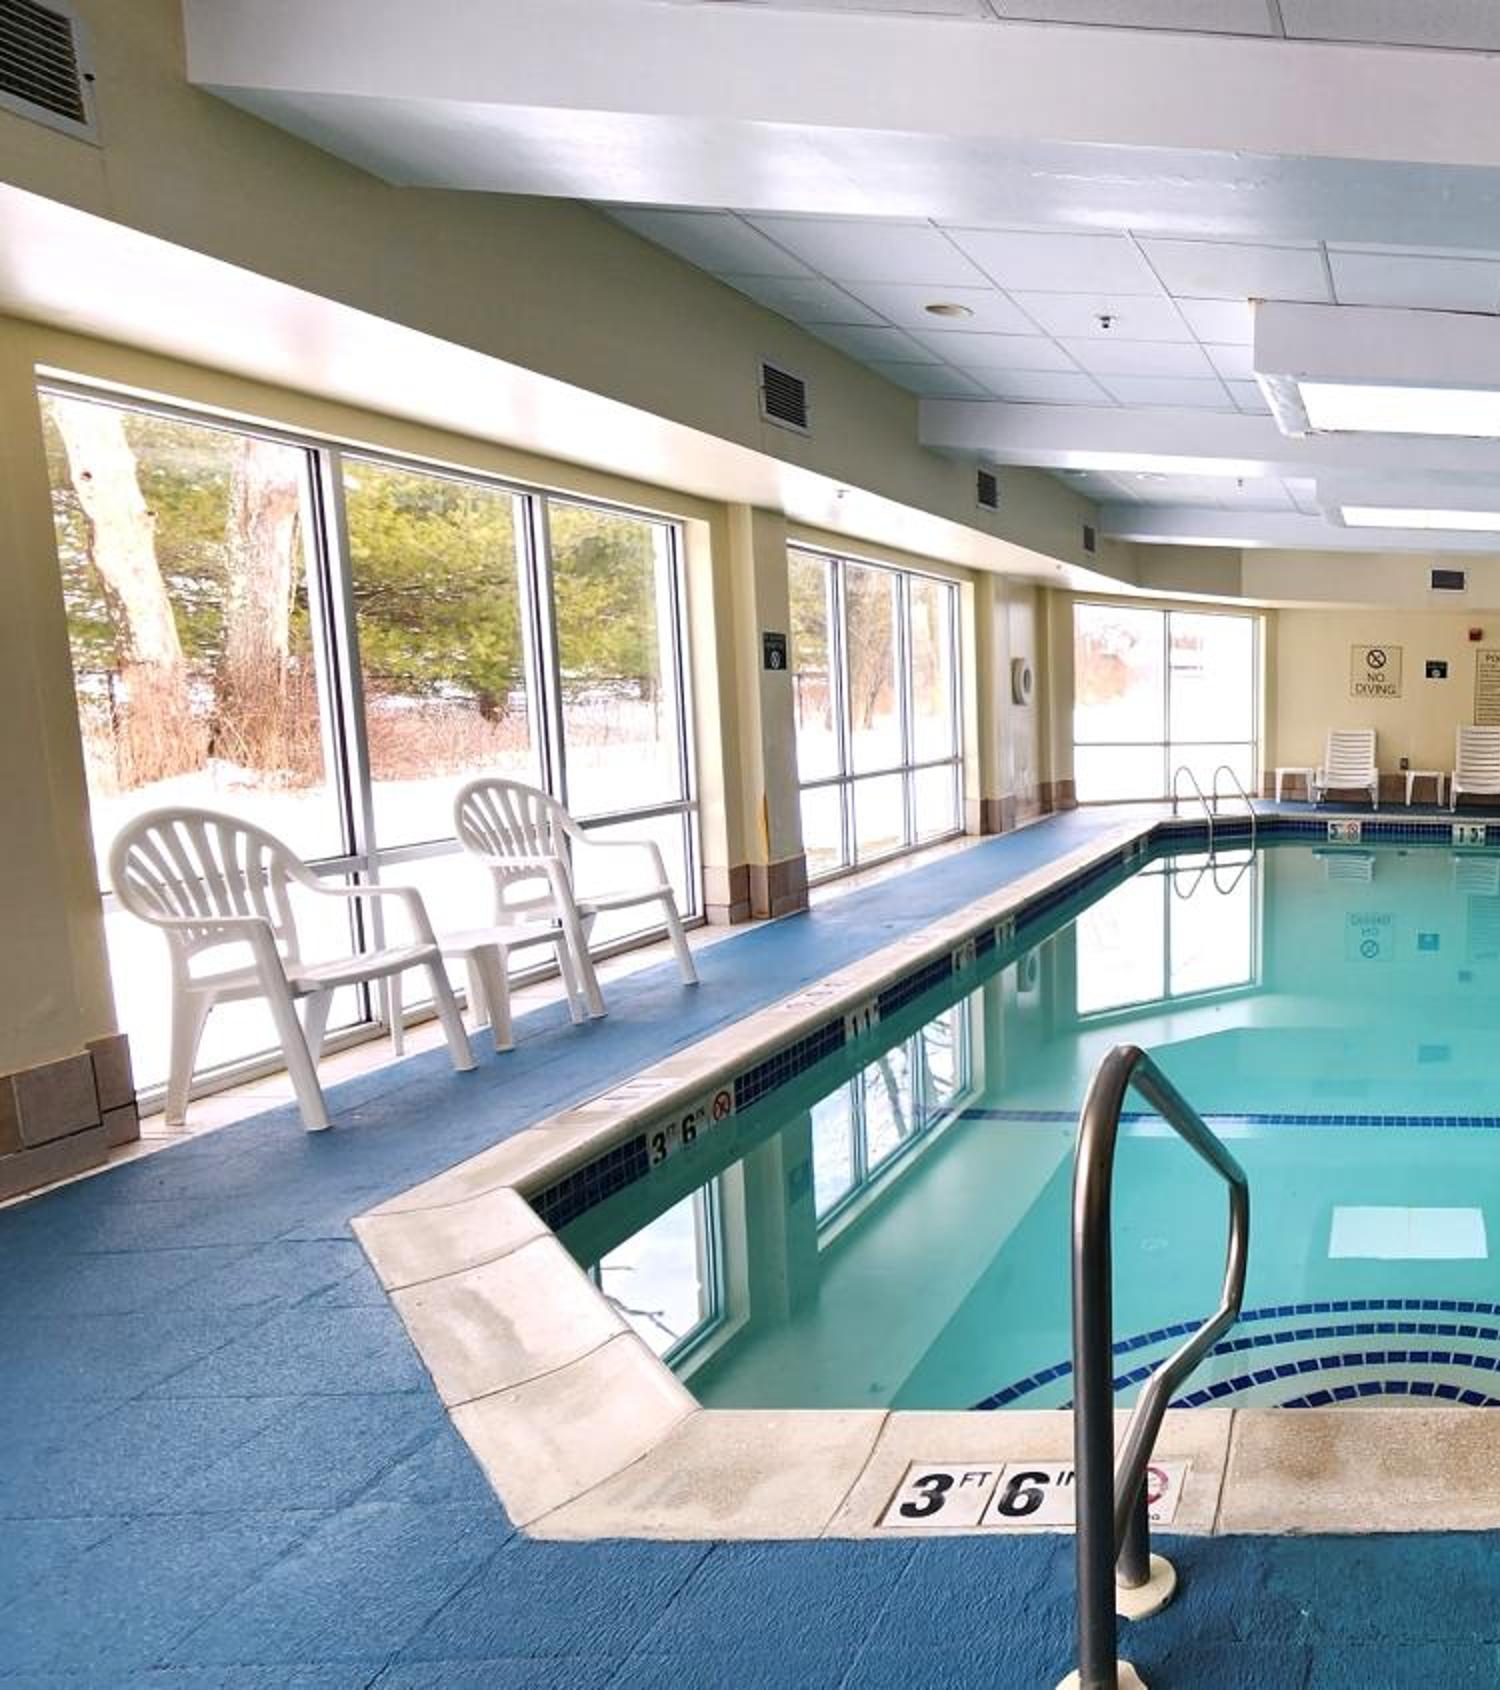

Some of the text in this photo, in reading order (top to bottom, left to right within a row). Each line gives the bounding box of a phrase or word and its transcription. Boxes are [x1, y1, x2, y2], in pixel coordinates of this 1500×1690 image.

[1355, 683, 1397, 695] DIVING
[1367, 672, 1385, 682] NO
[652, 1131, 667, 1165] 3
[681, 1112, 697, 1145] 6
[899, 1472, 955, 1518] 3
[959, 1471, 993, 1488] FT
[996, 1471, 1050, 1517] 6
